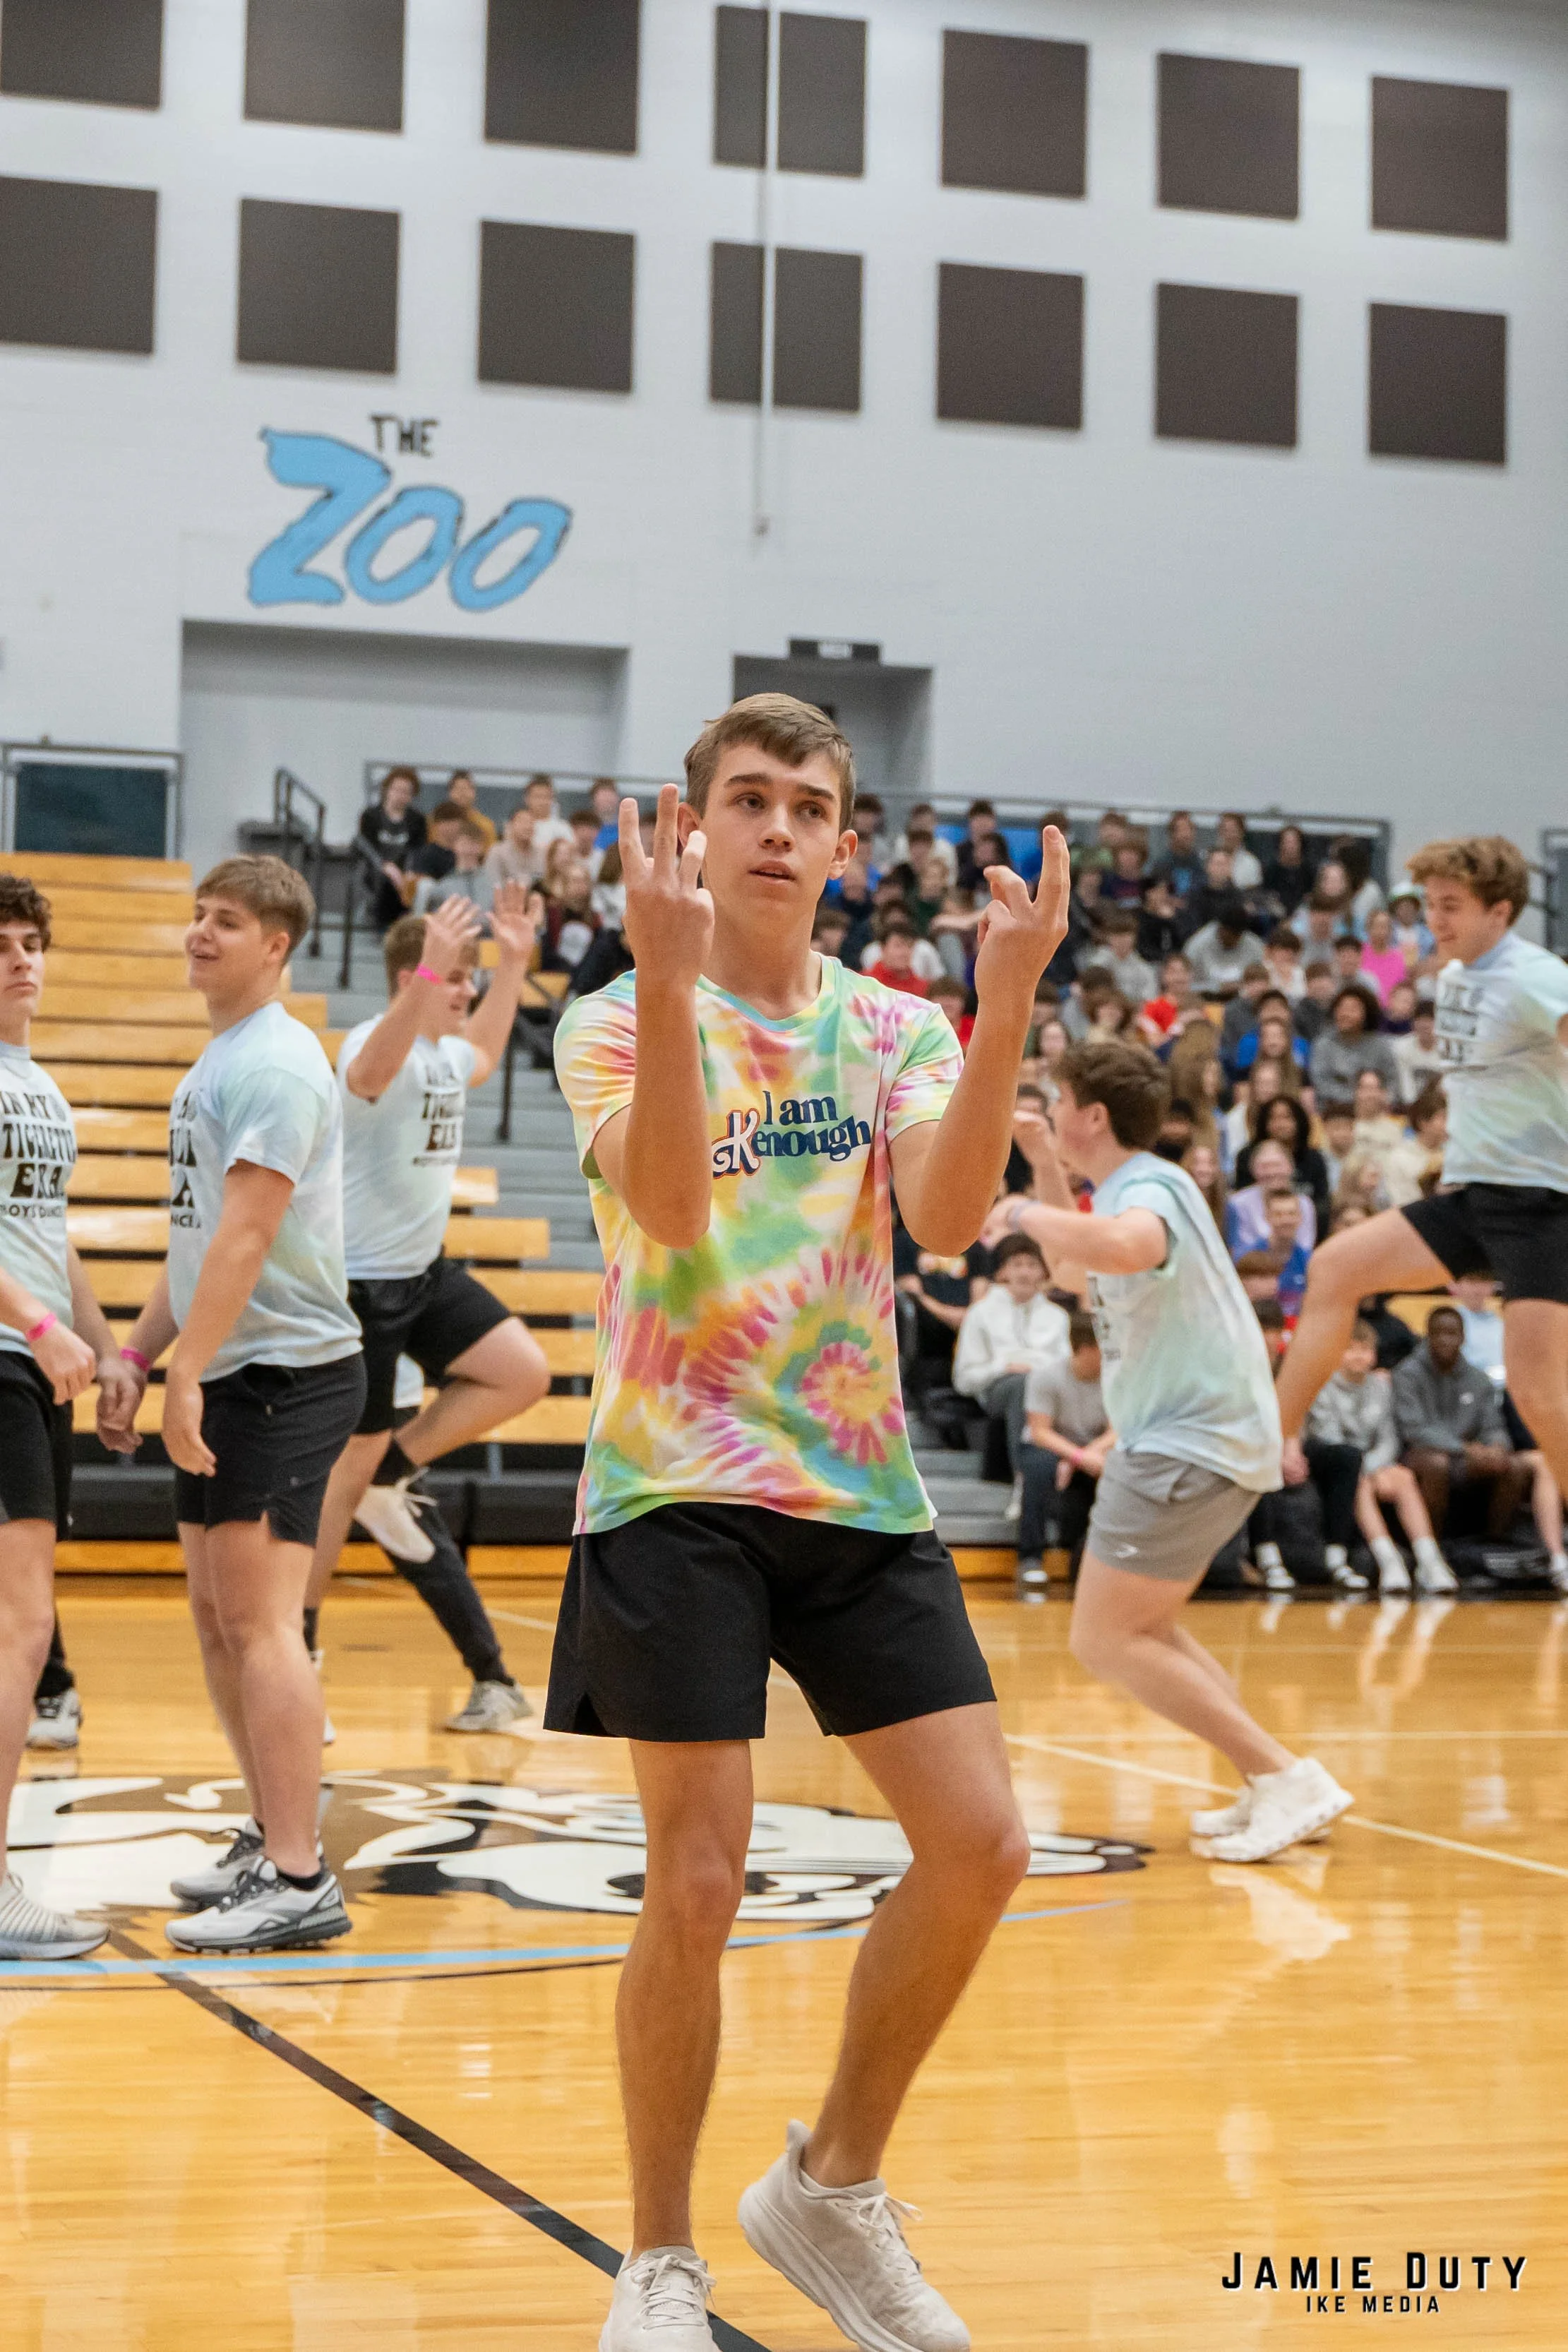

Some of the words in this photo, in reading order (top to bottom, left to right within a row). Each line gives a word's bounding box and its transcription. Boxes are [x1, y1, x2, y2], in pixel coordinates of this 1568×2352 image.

[369, 412, 439, 458] THE
[762, 1090, 773, 1125] I
[779, 1096, 839, 1126] am
[711, 1108, 872, 1180] Kenough
